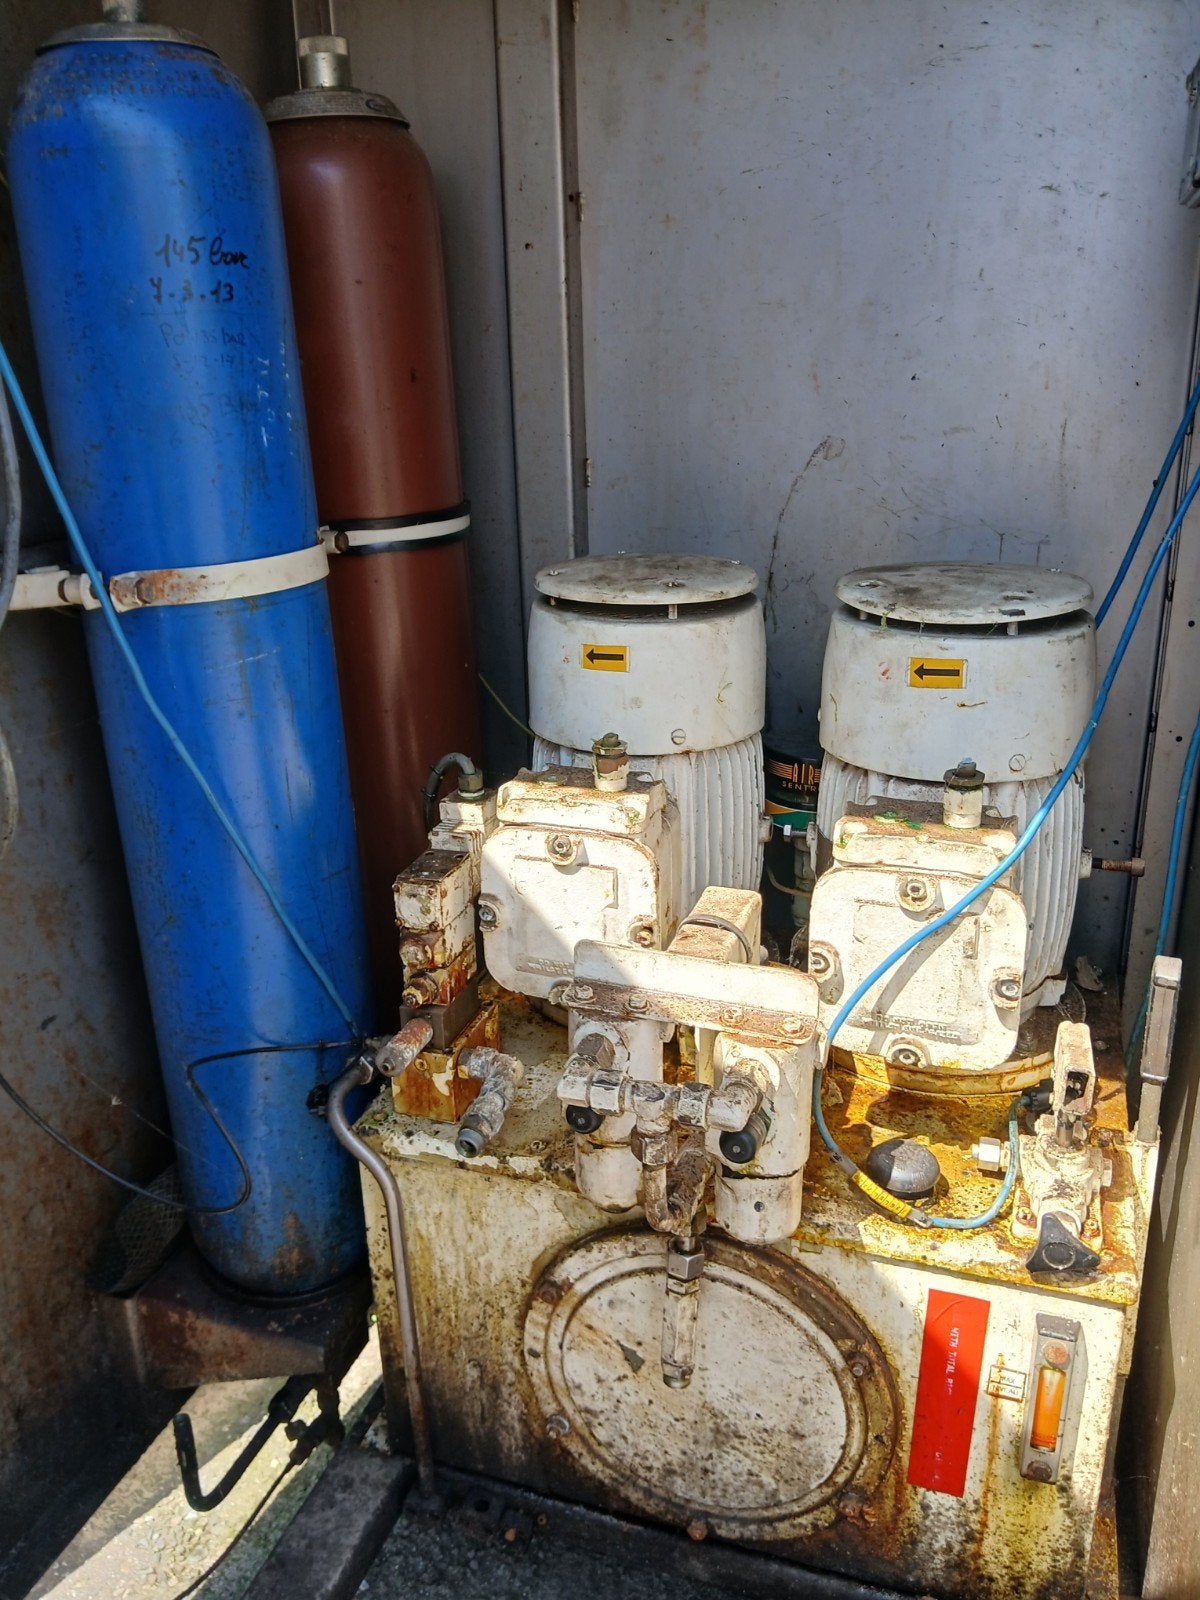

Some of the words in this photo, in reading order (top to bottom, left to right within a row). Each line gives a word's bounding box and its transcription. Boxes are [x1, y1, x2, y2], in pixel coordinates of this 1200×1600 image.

[155, 233, 206, 268] 145
[792, 762, 815, 785] AIR
[781, 780, 818, 792] SENTR
